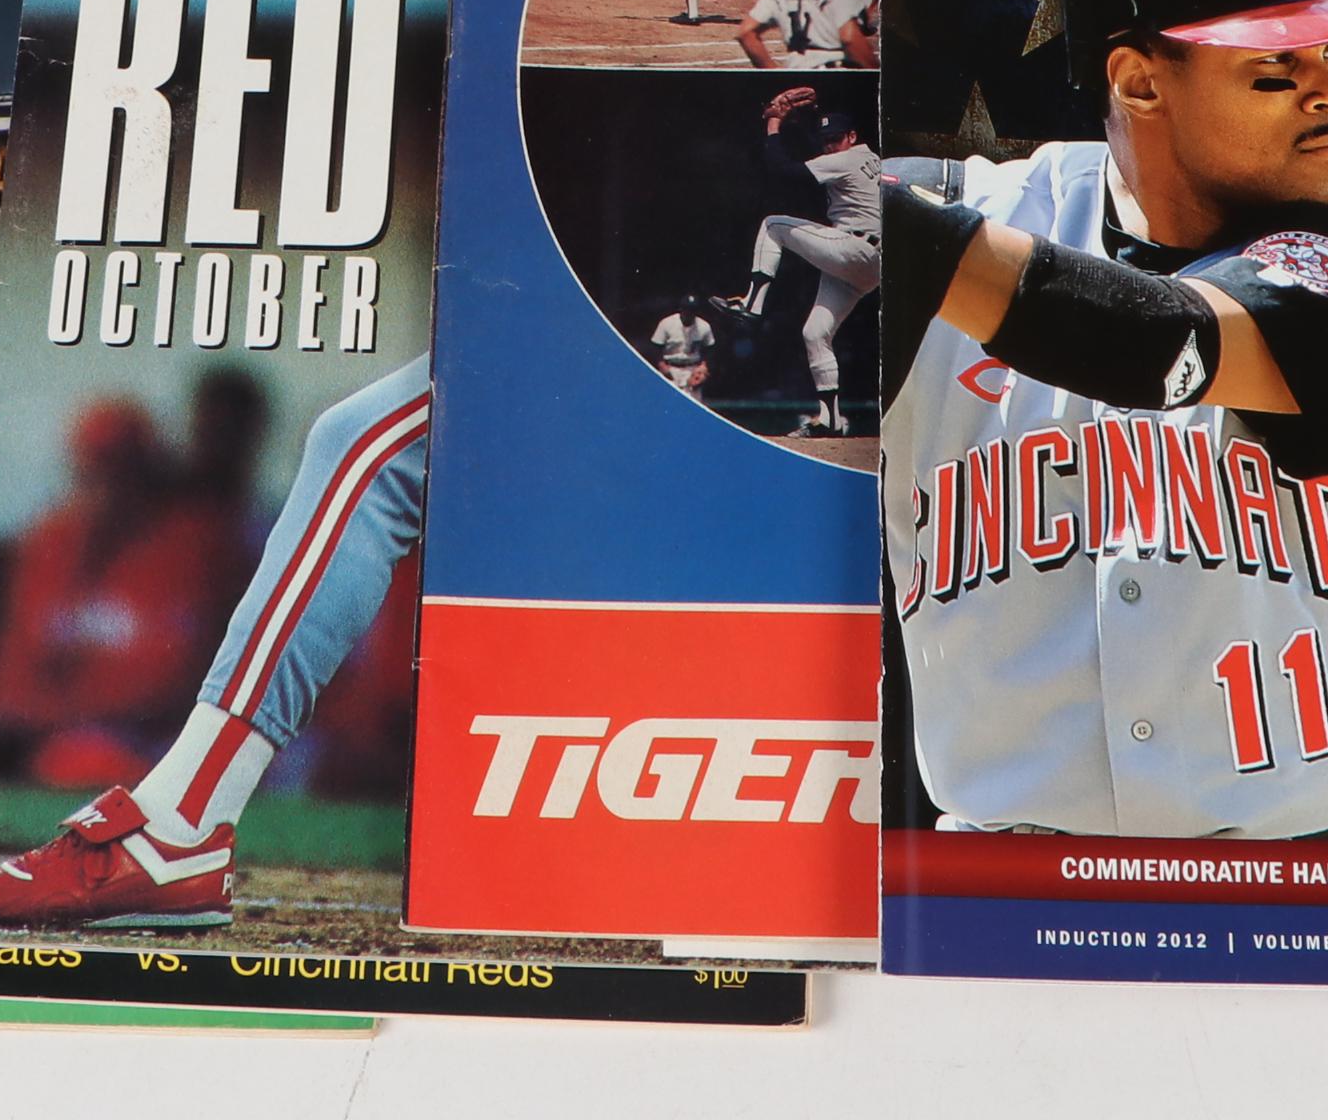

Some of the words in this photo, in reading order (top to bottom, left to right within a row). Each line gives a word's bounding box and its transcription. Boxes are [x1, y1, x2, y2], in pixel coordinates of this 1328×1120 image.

[48, 249, 380, 353] OCTOBER
[1060, 856, 1284, 885] COMMEMORATIVE
[1036, 929, 1149, 949] INDUCTION
[1156, 931, 1208, 950] 2012
